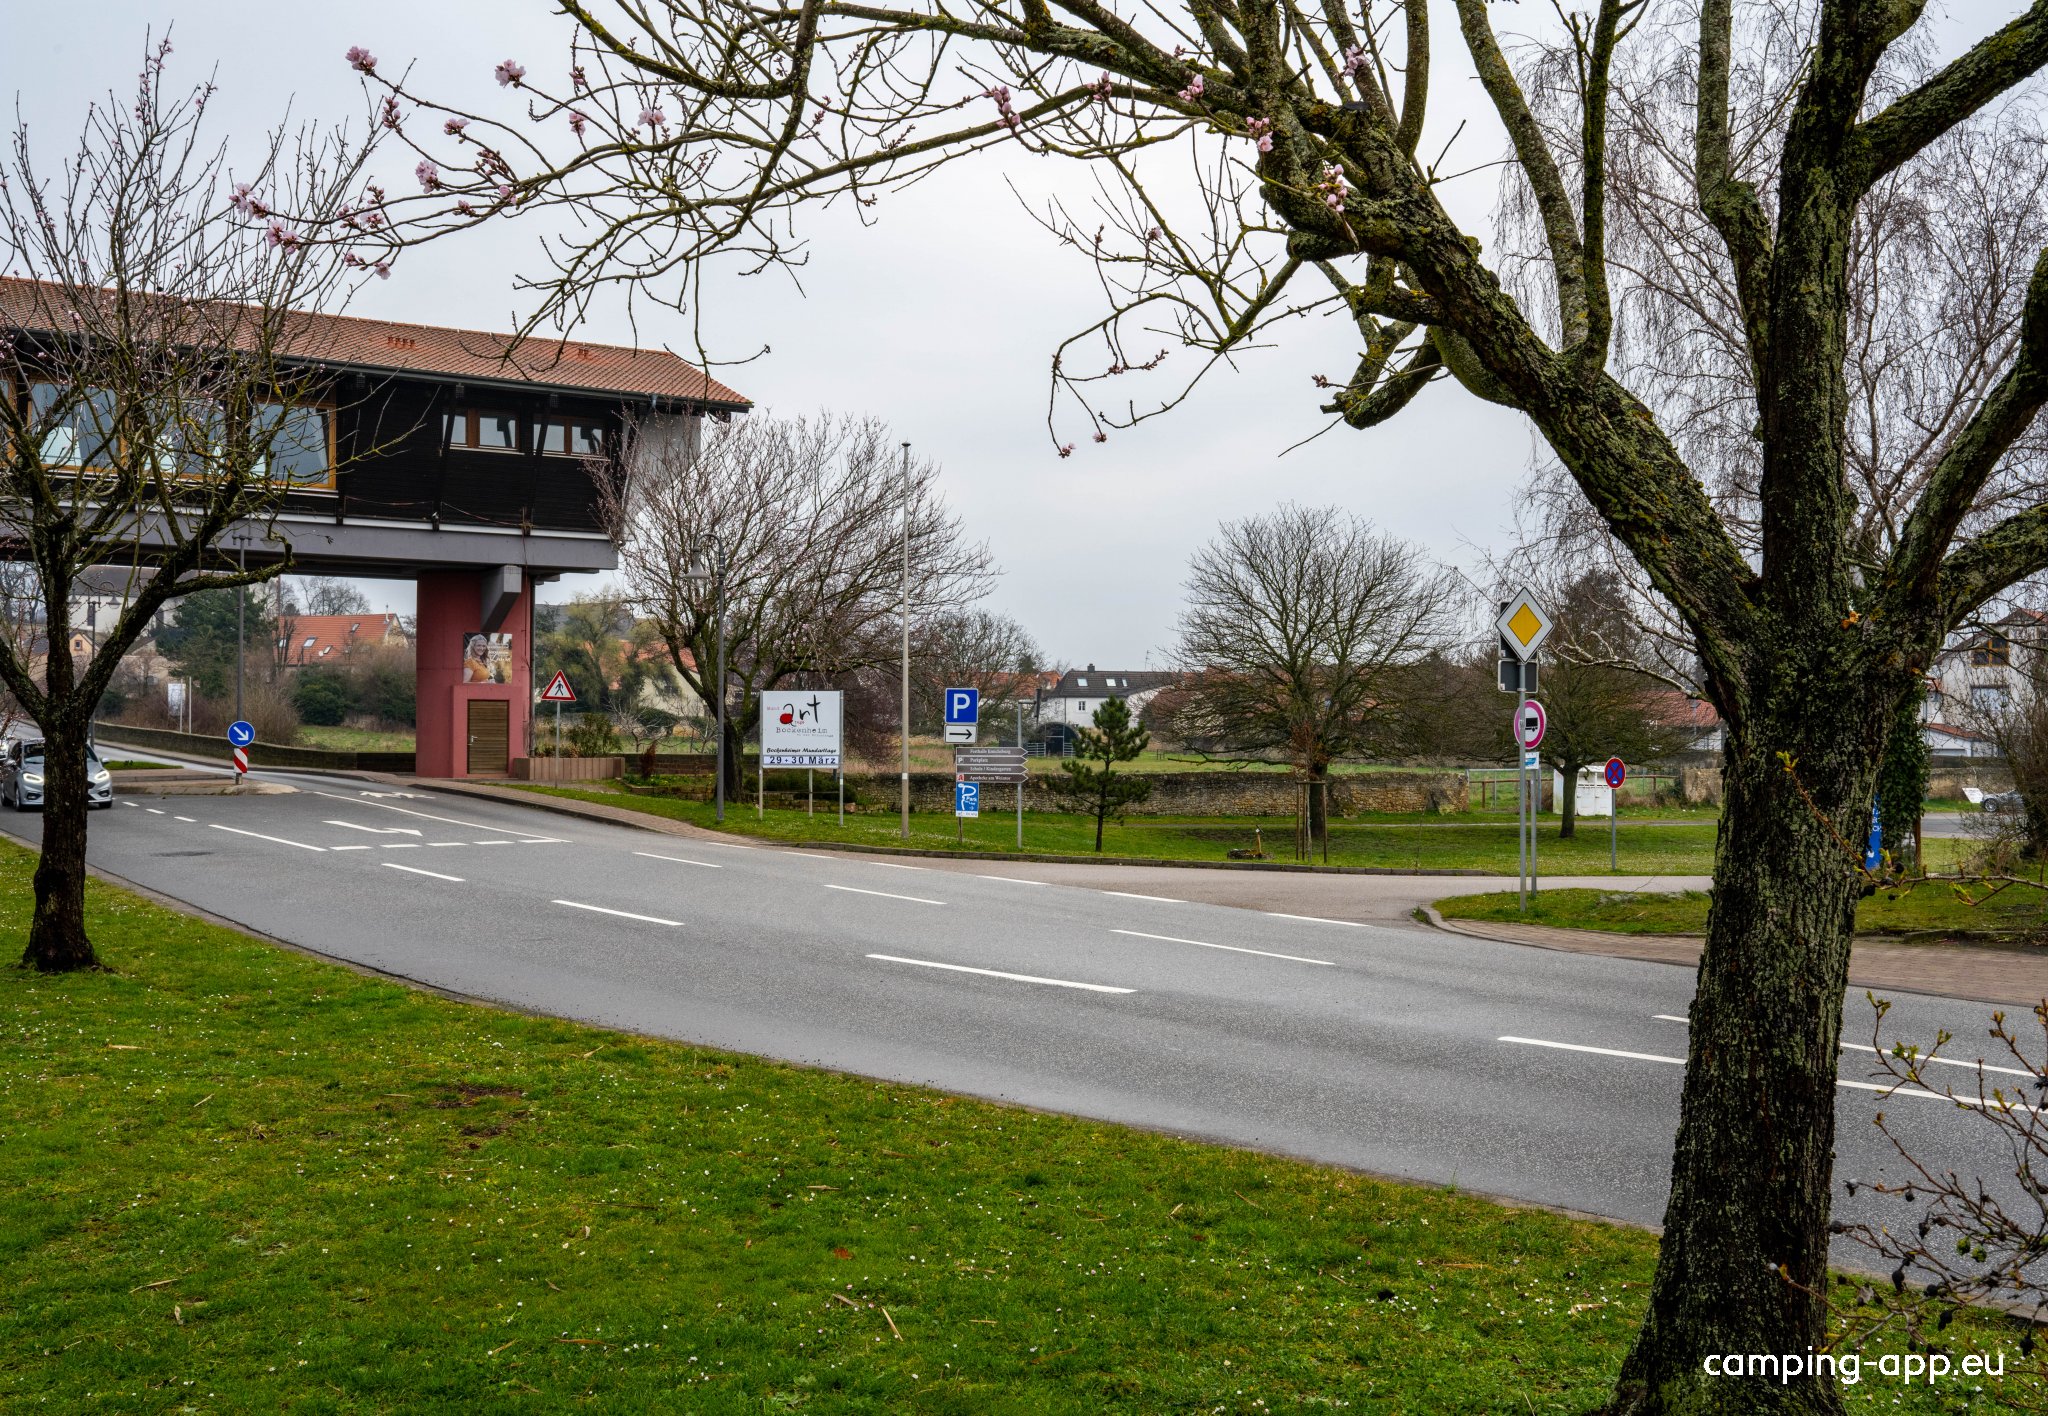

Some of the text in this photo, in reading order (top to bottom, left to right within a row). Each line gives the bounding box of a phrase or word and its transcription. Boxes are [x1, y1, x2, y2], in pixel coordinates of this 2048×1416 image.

[779, 694, 821, 727] art
[953, 693, 971, 719] P
[769, 756, 782, 764] 29
[791, 756, 804, 764] 30
[808, 755, 836, 764] März
